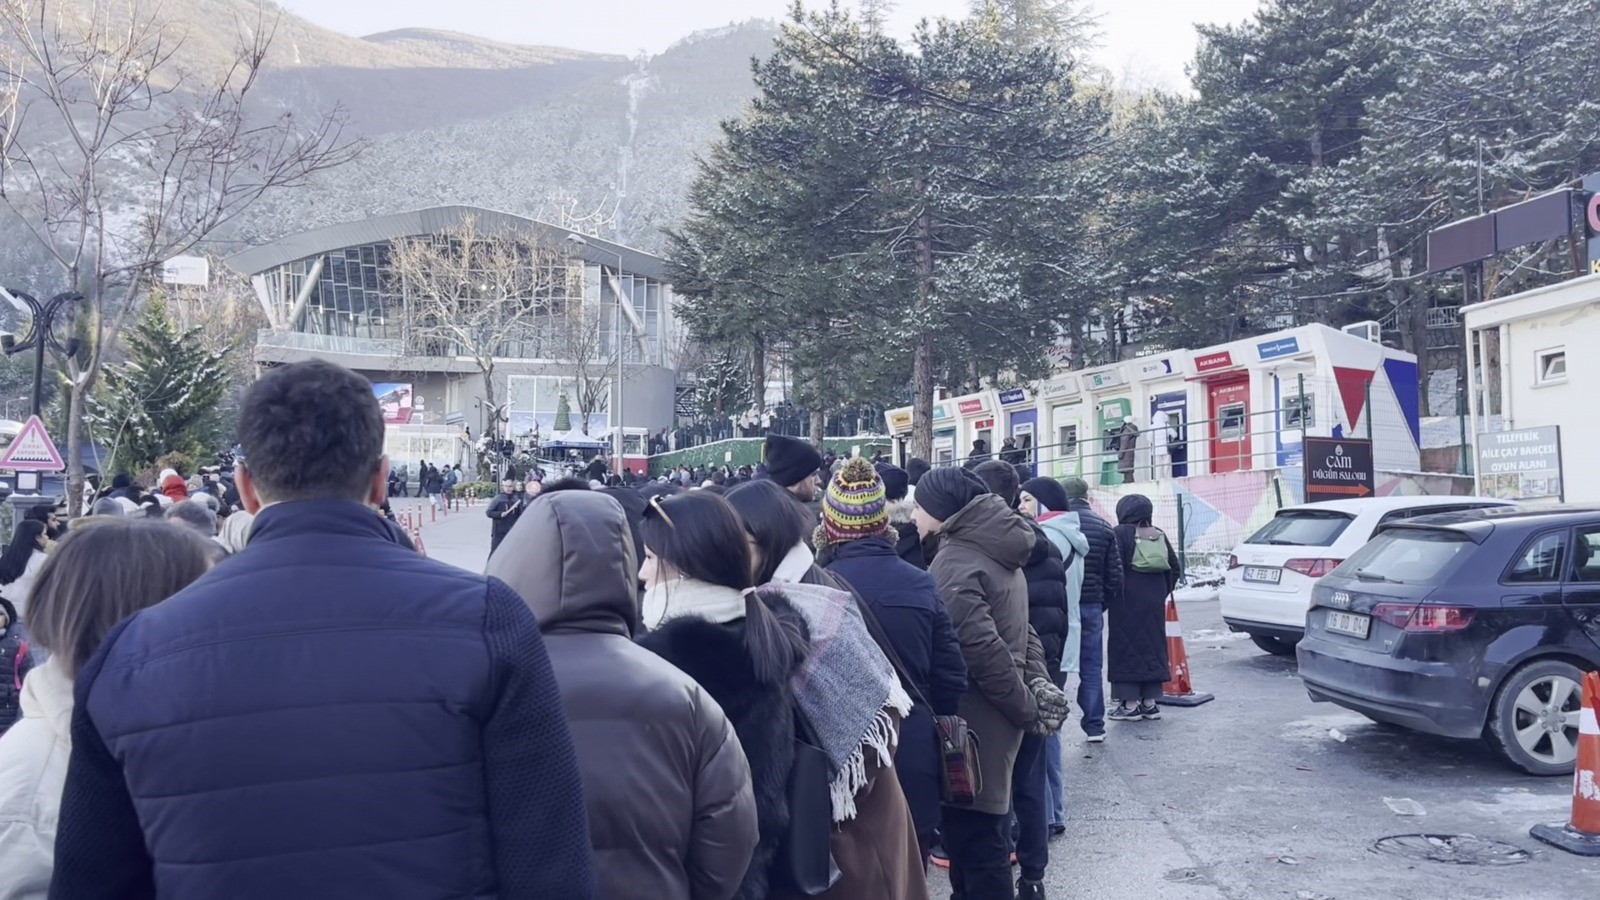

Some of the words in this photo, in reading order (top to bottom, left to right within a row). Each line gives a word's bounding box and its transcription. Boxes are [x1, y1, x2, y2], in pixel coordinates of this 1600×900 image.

[1200, 356, 1228, 367] AKBANK
[1219, 385, 1244, 394] AKBANK
[1496, 430, 1540, 444] TELEFERİK
[1481, 448, 1499, 459] AİLE
[1501, 447, 1518, 459] ÇAY
[1491, 461, 1517, 472] OYUN
[1519, 460, 1547, 470] ALANI
